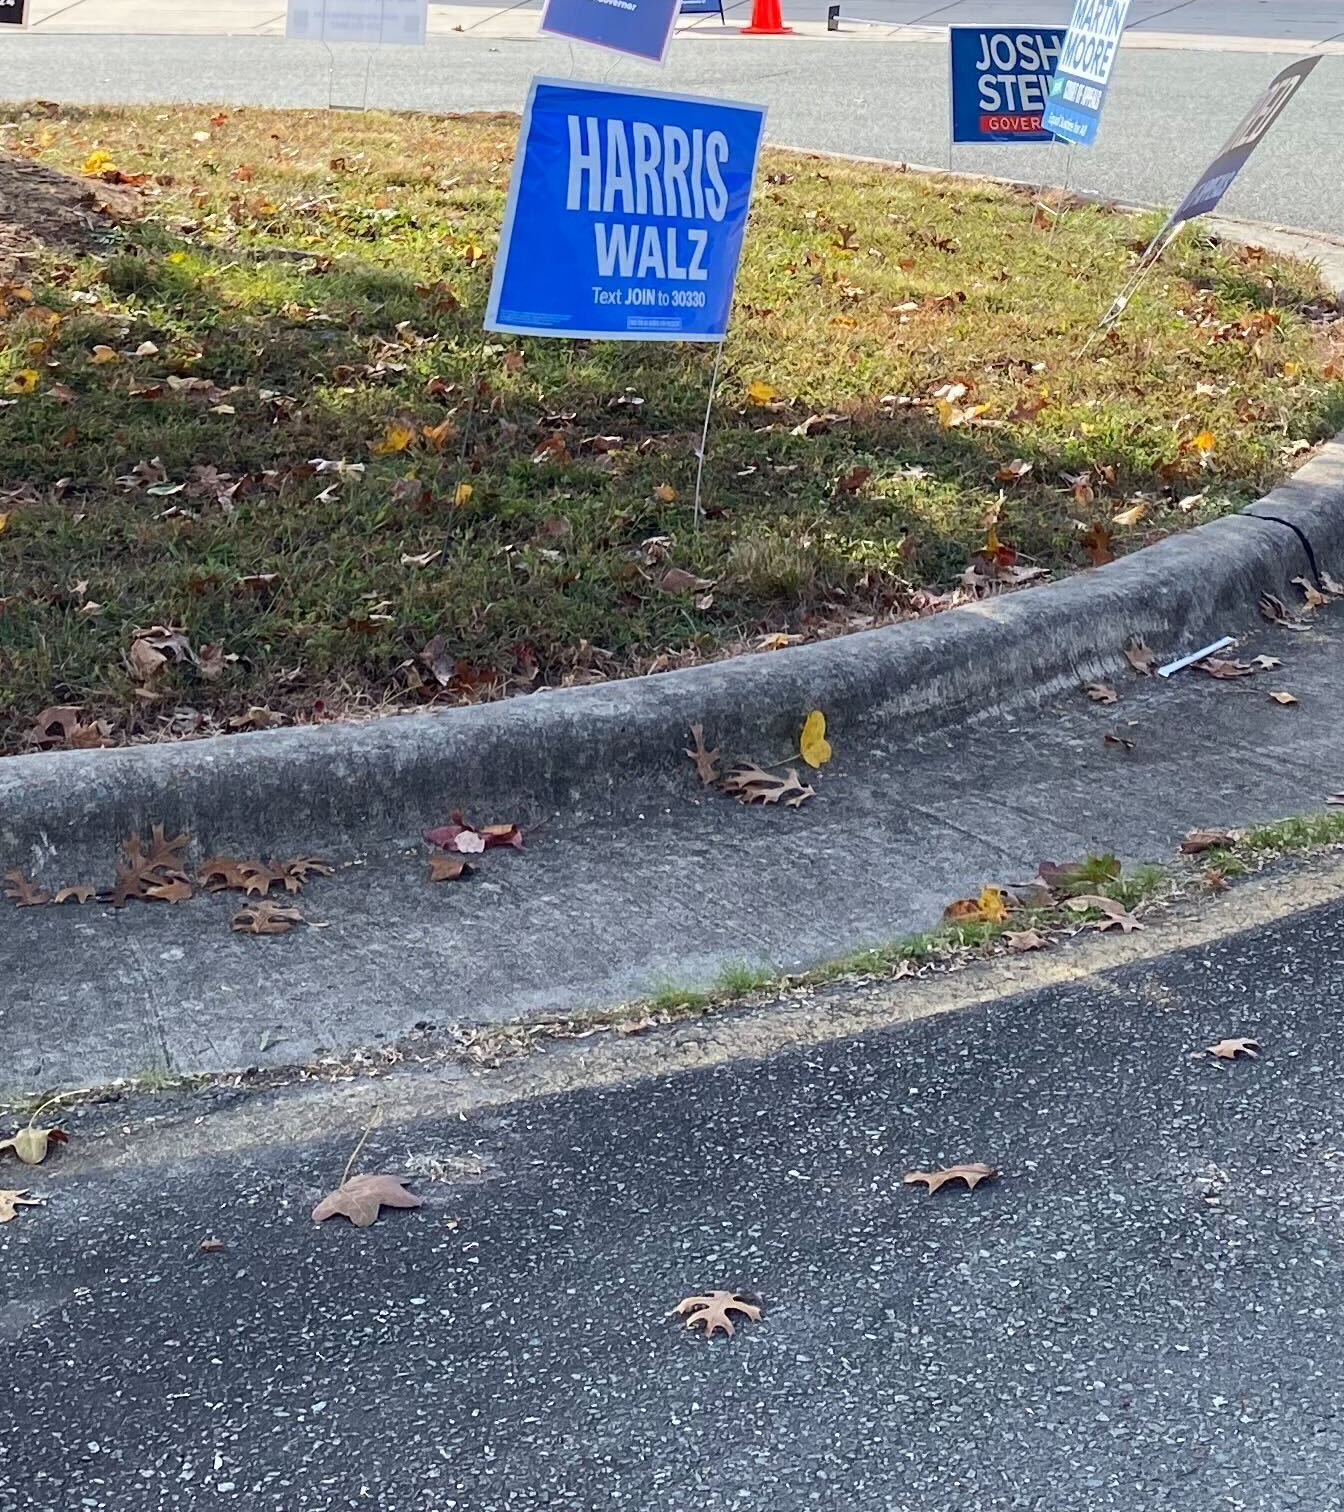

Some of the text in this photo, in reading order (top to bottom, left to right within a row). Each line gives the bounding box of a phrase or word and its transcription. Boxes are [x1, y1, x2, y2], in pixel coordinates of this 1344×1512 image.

[976, 34, 1062, 71] JOSH
[1062, 32, 1113, 77] MOORE
[989, 116, 1042, 131] GOVER
[566, 114, 729, 222] HARRIS
[594, 222, 708, 281] WALZ
[591, 286, 706, 308] Text JOIN to 30330
